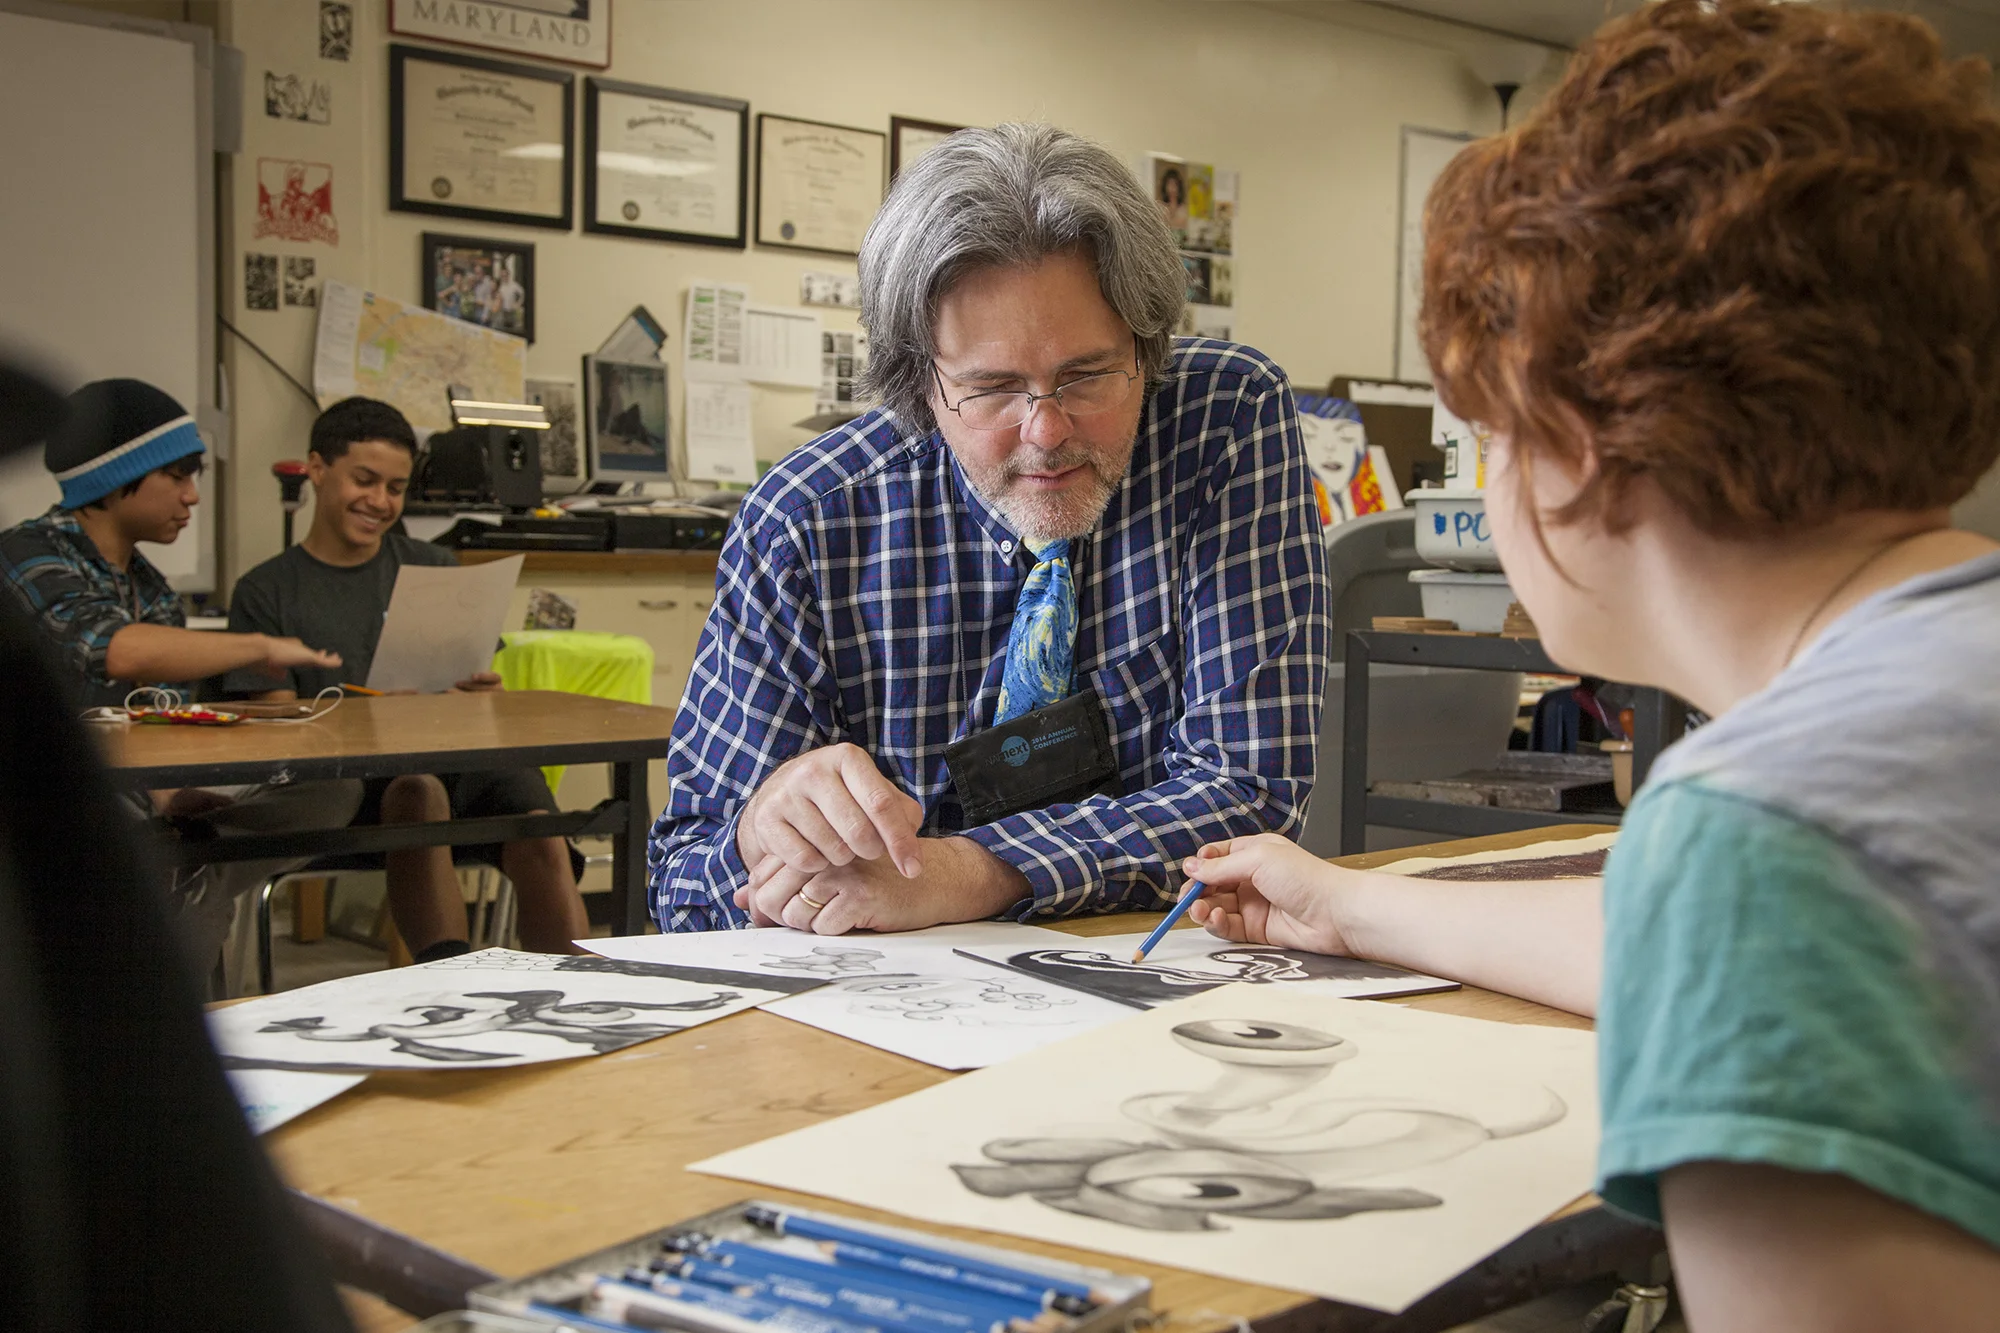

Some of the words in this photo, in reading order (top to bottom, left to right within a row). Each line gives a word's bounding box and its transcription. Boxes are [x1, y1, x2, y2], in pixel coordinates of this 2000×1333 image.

[413, 0, 592, 48] MARYLAND
[1032, 735, 1047, 744] 2014
[1048, 726, 1076, 739] ANNUAL
[1033, 732, 1078, 750] CONFERENCE
